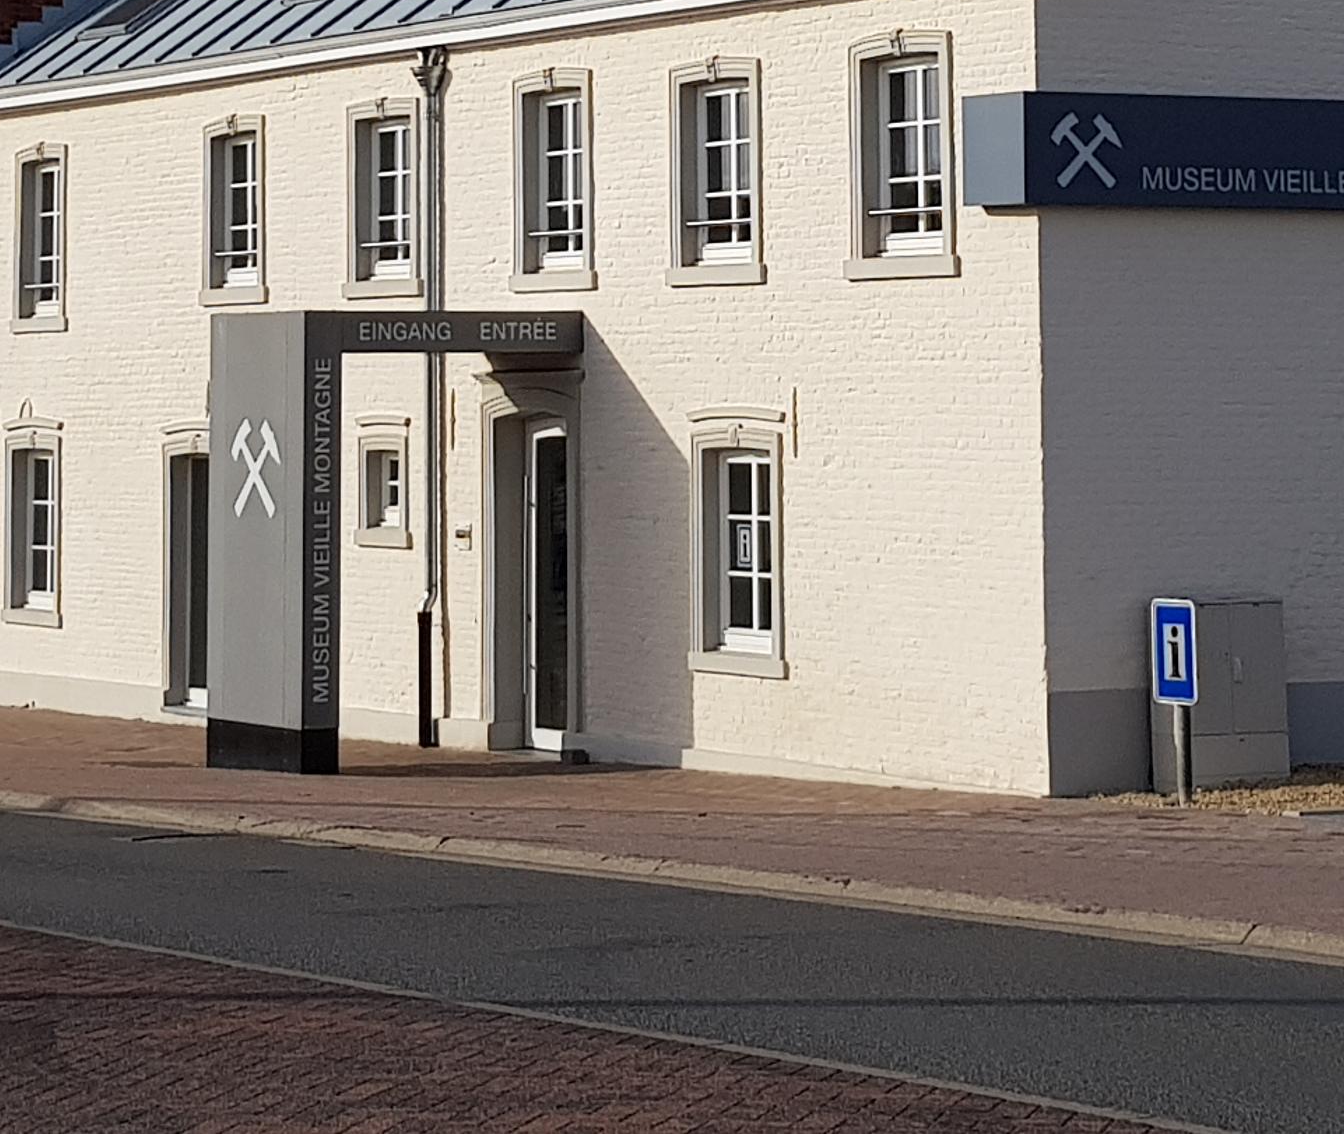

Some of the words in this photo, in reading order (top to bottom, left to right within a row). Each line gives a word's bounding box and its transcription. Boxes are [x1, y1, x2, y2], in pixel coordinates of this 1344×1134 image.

[1142, 166, 1256, 192] MUSEUM
[359, 321, 452, 342] EINGANG
[479, 317, 556, 341] ENTRÉE
[313, 358, 332, 493] MONTAGNE
[312, 500, 331, 588] VIEILLE
[312, 594, 331, 704] MUSEUM
